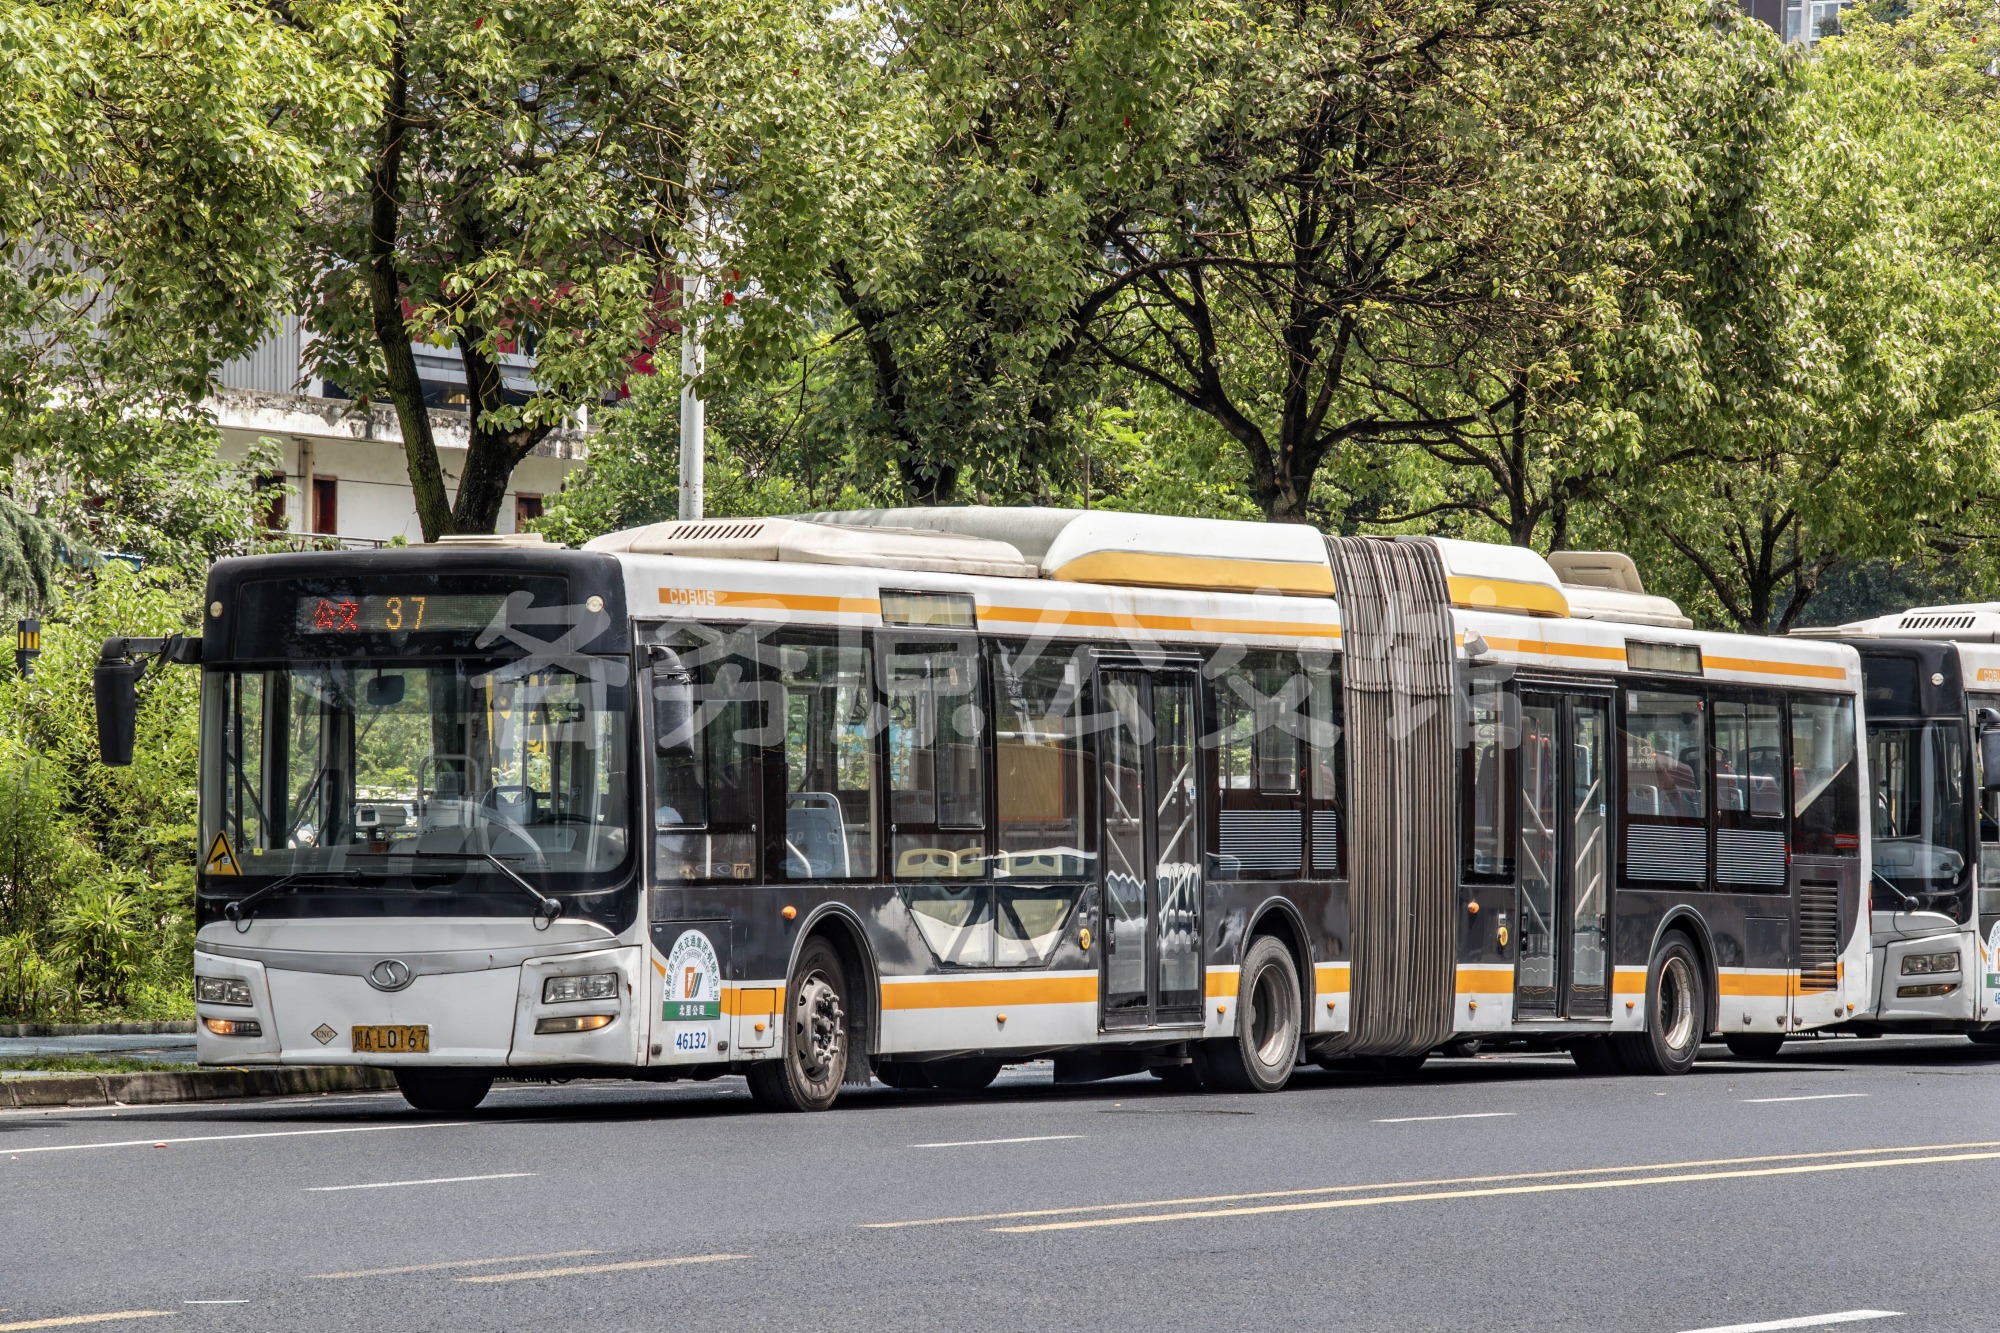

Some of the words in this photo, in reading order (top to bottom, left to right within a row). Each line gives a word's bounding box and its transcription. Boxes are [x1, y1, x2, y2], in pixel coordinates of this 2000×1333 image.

[314, 598, 358, 630] 公交
[386, 597, 425, 630] 37
[665, 935, 719, 1001] 成都市公共交通集团有限公司
[316, 1030, 333, 1038] CNG
[676, 1032, 706, 1050] 46132
